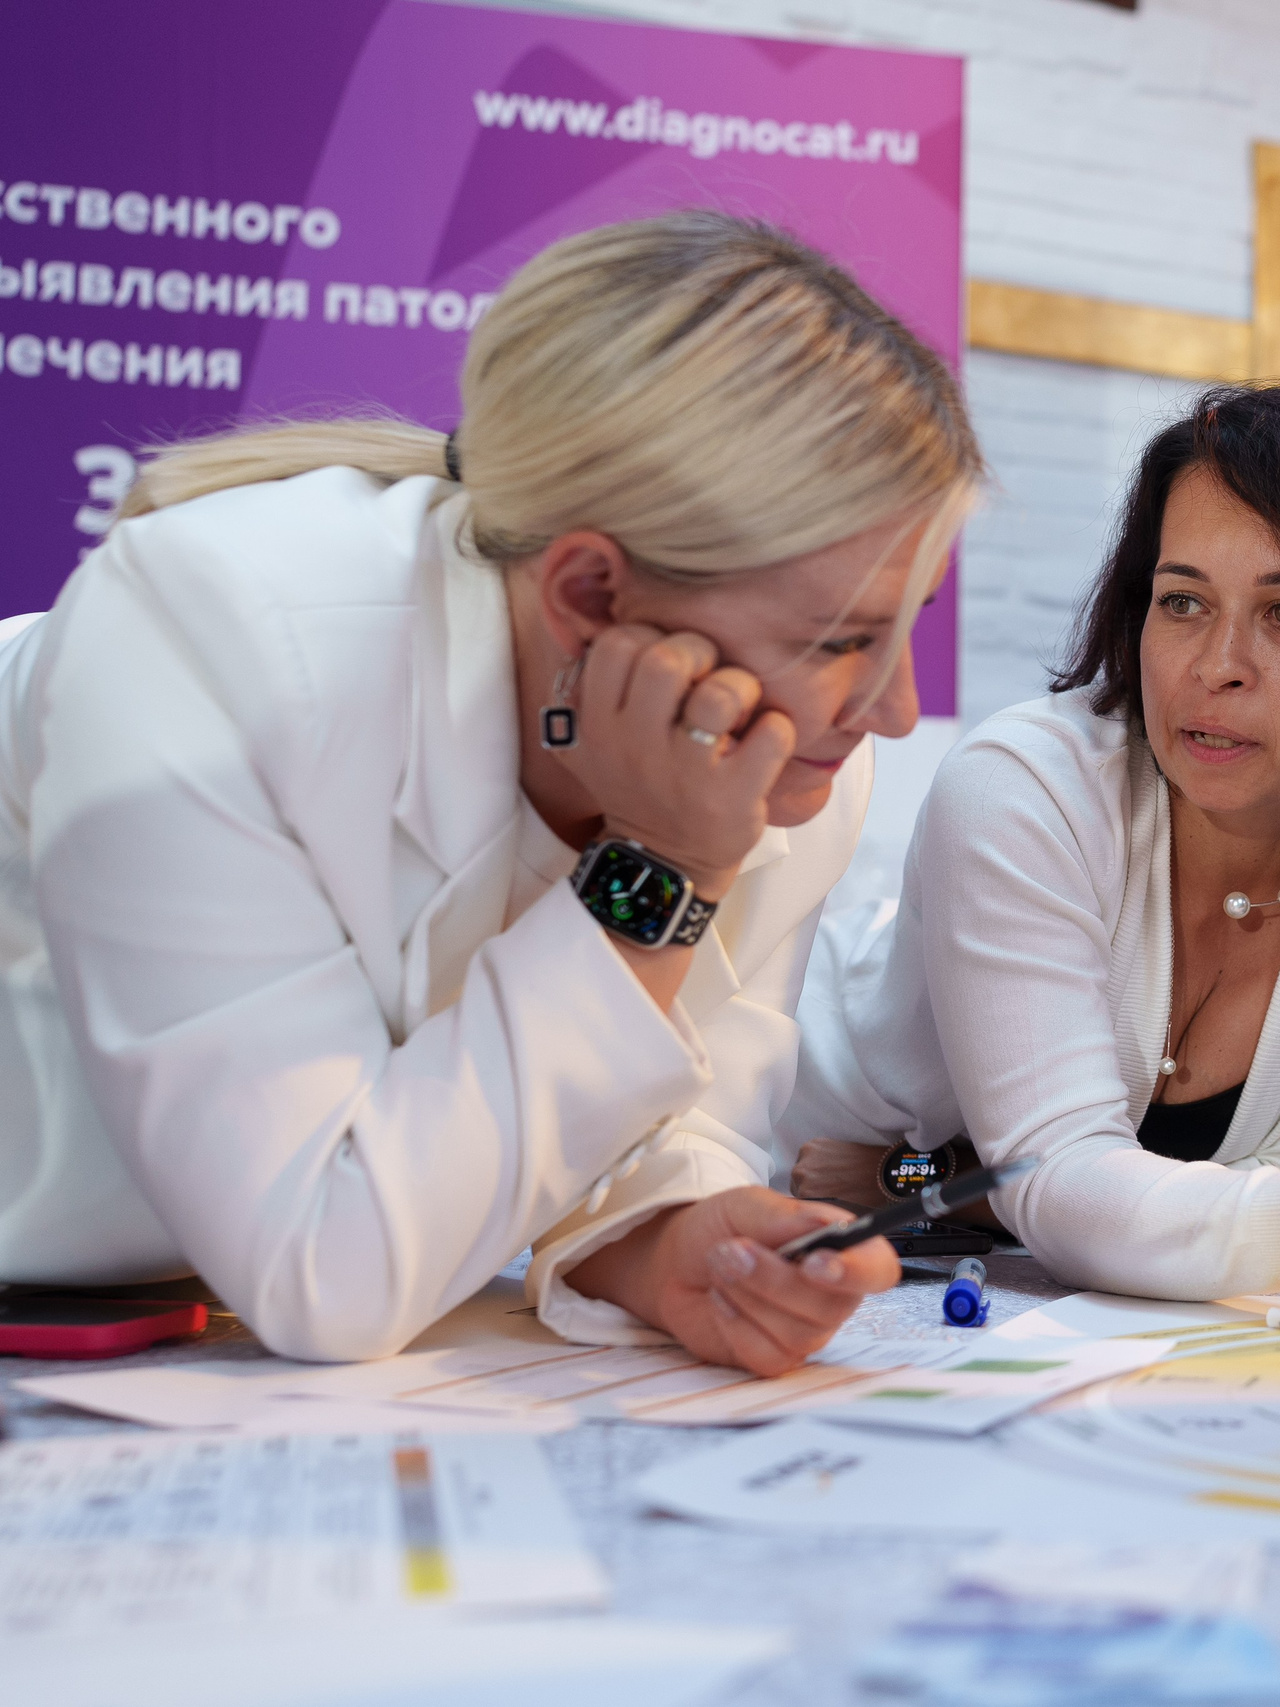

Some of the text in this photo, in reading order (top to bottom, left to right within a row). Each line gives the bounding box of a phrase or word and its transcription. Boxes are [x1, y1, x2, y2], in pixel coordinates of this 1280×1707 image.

[475, 89, 920, 165] www.diagnocat.ru
[0, 179, 342, 249] ственного
[0, 331, 242, 391] ечения
[899, 1163, 936, 1176] 16:46
